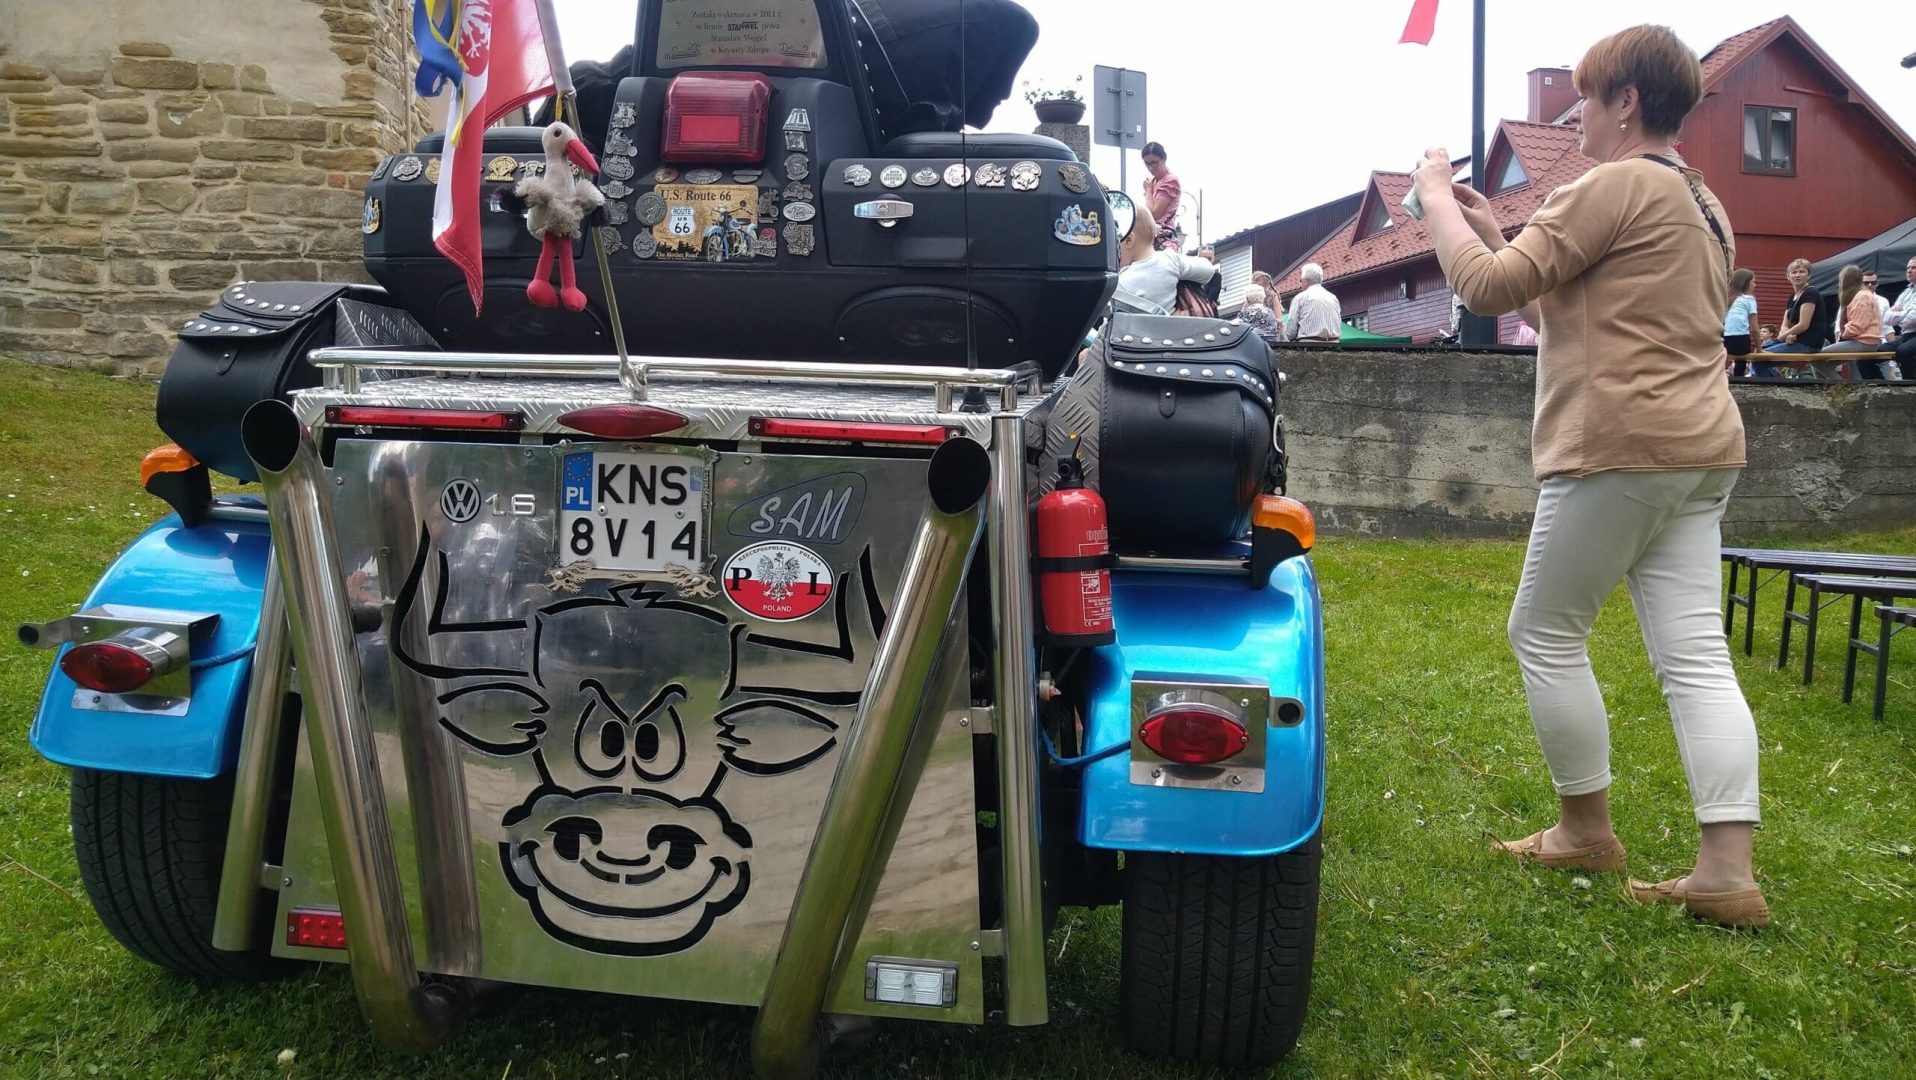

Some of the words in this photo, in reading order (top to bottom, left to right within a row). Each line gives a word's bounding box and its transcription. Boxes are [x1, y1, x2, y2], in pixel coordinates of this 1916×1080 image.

[728, 22, 759, 31] STANWEL
[661, 190, 682, 200] U.S.
[686, 190, 717, 200] Route
[720, 191, 732, 201] 66
[674, 222, 690, 234] 66
[598, 463, 688, 506] KNS
[441, 479, 480, 522] VW
[565, 487, 590, 505] PL
[749, 486, 854, 540] SAM
[799, 550, 822, 567] POLSKA
[730, 566, 753, 591] P
[807, 571, 827, 596] L
[762, 604, 792, 612] POLAND
